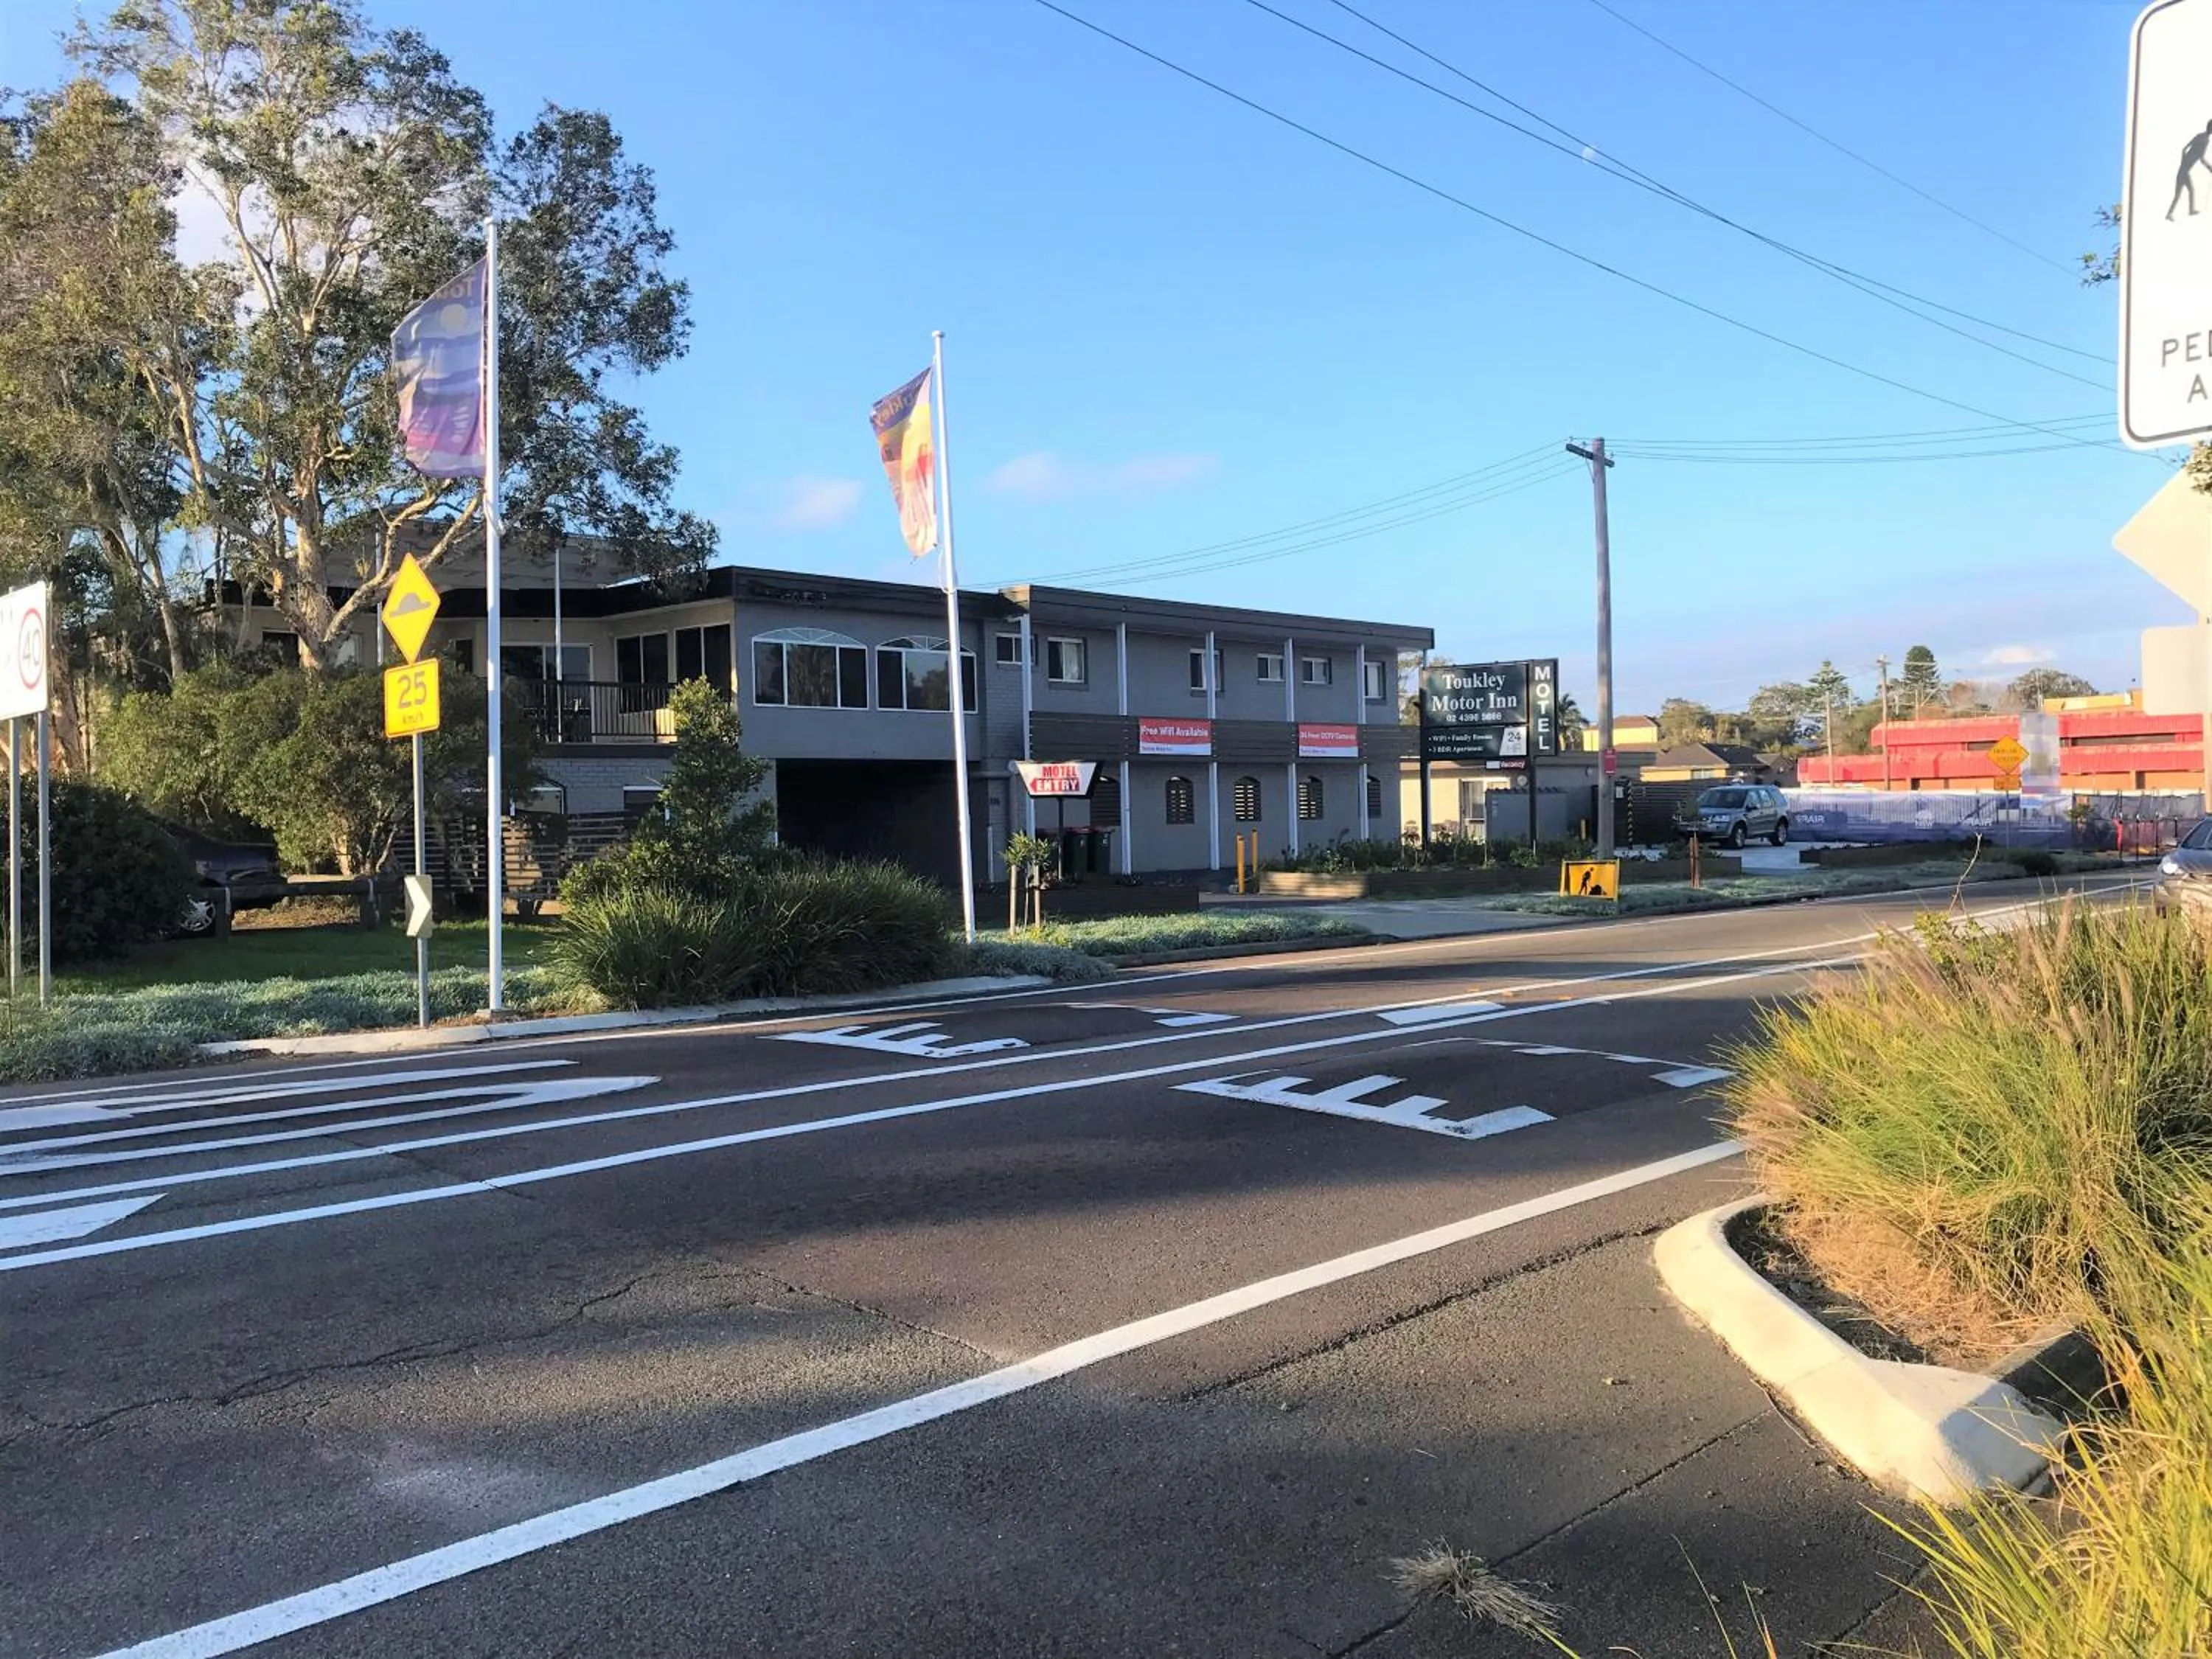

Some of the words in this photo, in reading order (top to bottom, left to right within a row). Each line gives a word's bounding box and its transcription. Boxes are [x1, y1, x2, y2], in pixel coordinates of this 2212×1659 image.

[2161, 329, 2212, 368] PE
[23, 628, 42, 670] 40
[397, 671, 427, 709] 25
[1442, 672, 1506, 691] Toukley
[1431, 695, 1484, 712] Motor
[1488, 692, 1517, 709] Inn
[1534, 666, 1551, 750] MOTEL
[1507, 731, 1522, 742] 24
[1042, 766, 1077, 777] MOTEL
[1037, 779, 1078, 791] ENTRY
